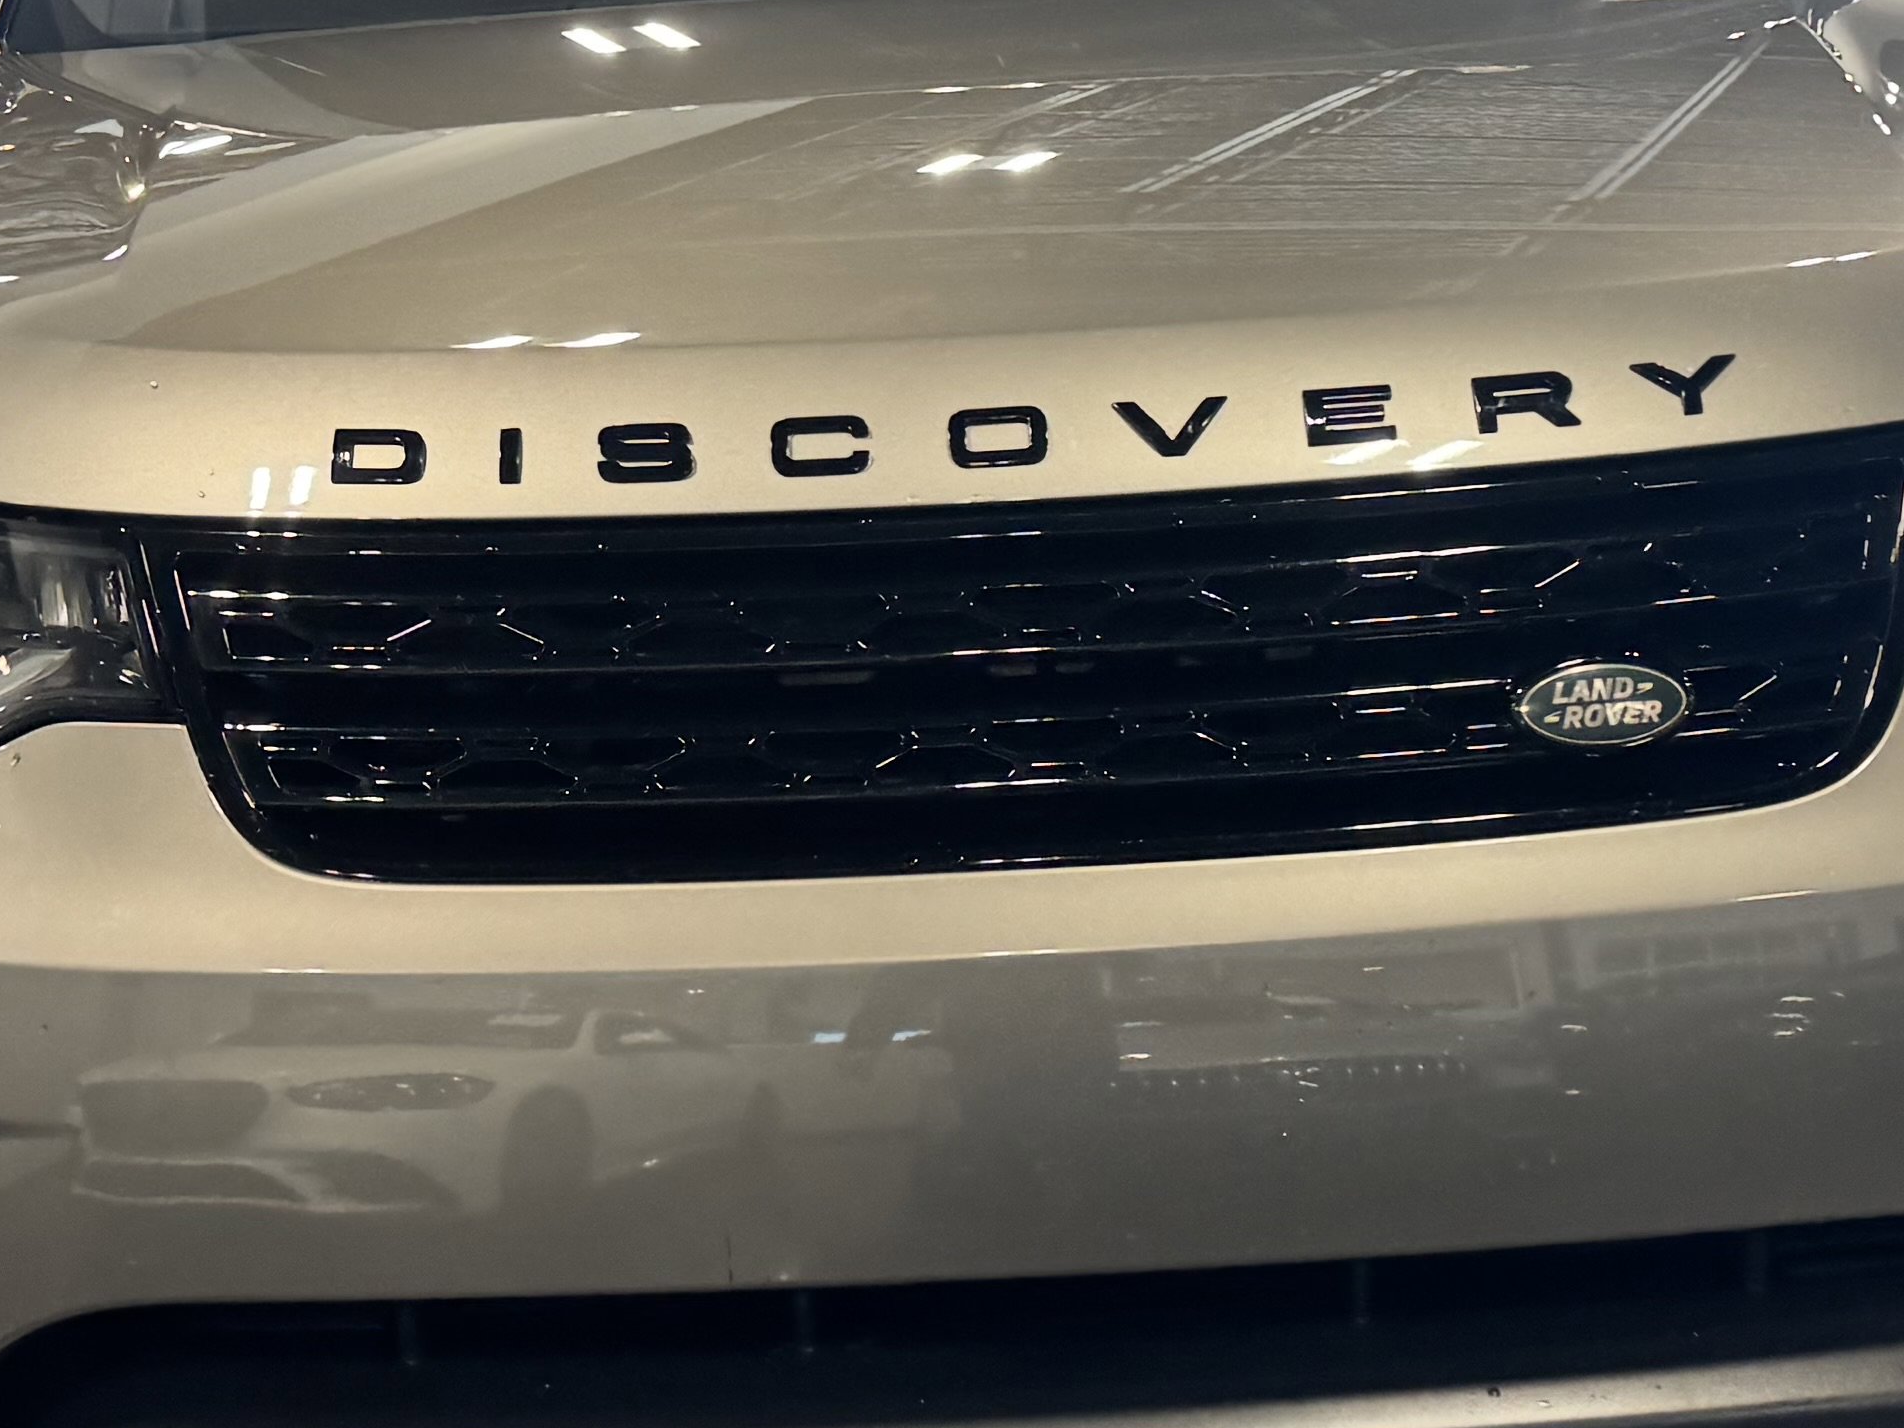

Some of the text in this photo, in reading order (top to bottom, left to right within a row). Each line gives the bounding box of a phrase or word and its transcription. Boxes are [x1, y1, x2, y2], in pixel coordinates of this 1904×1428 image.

[331, 353, 1735, 485] DISCOVERY
[1552, 676, 1635, 705] LAND
[1562, 700, 1663, 730] ROVER
